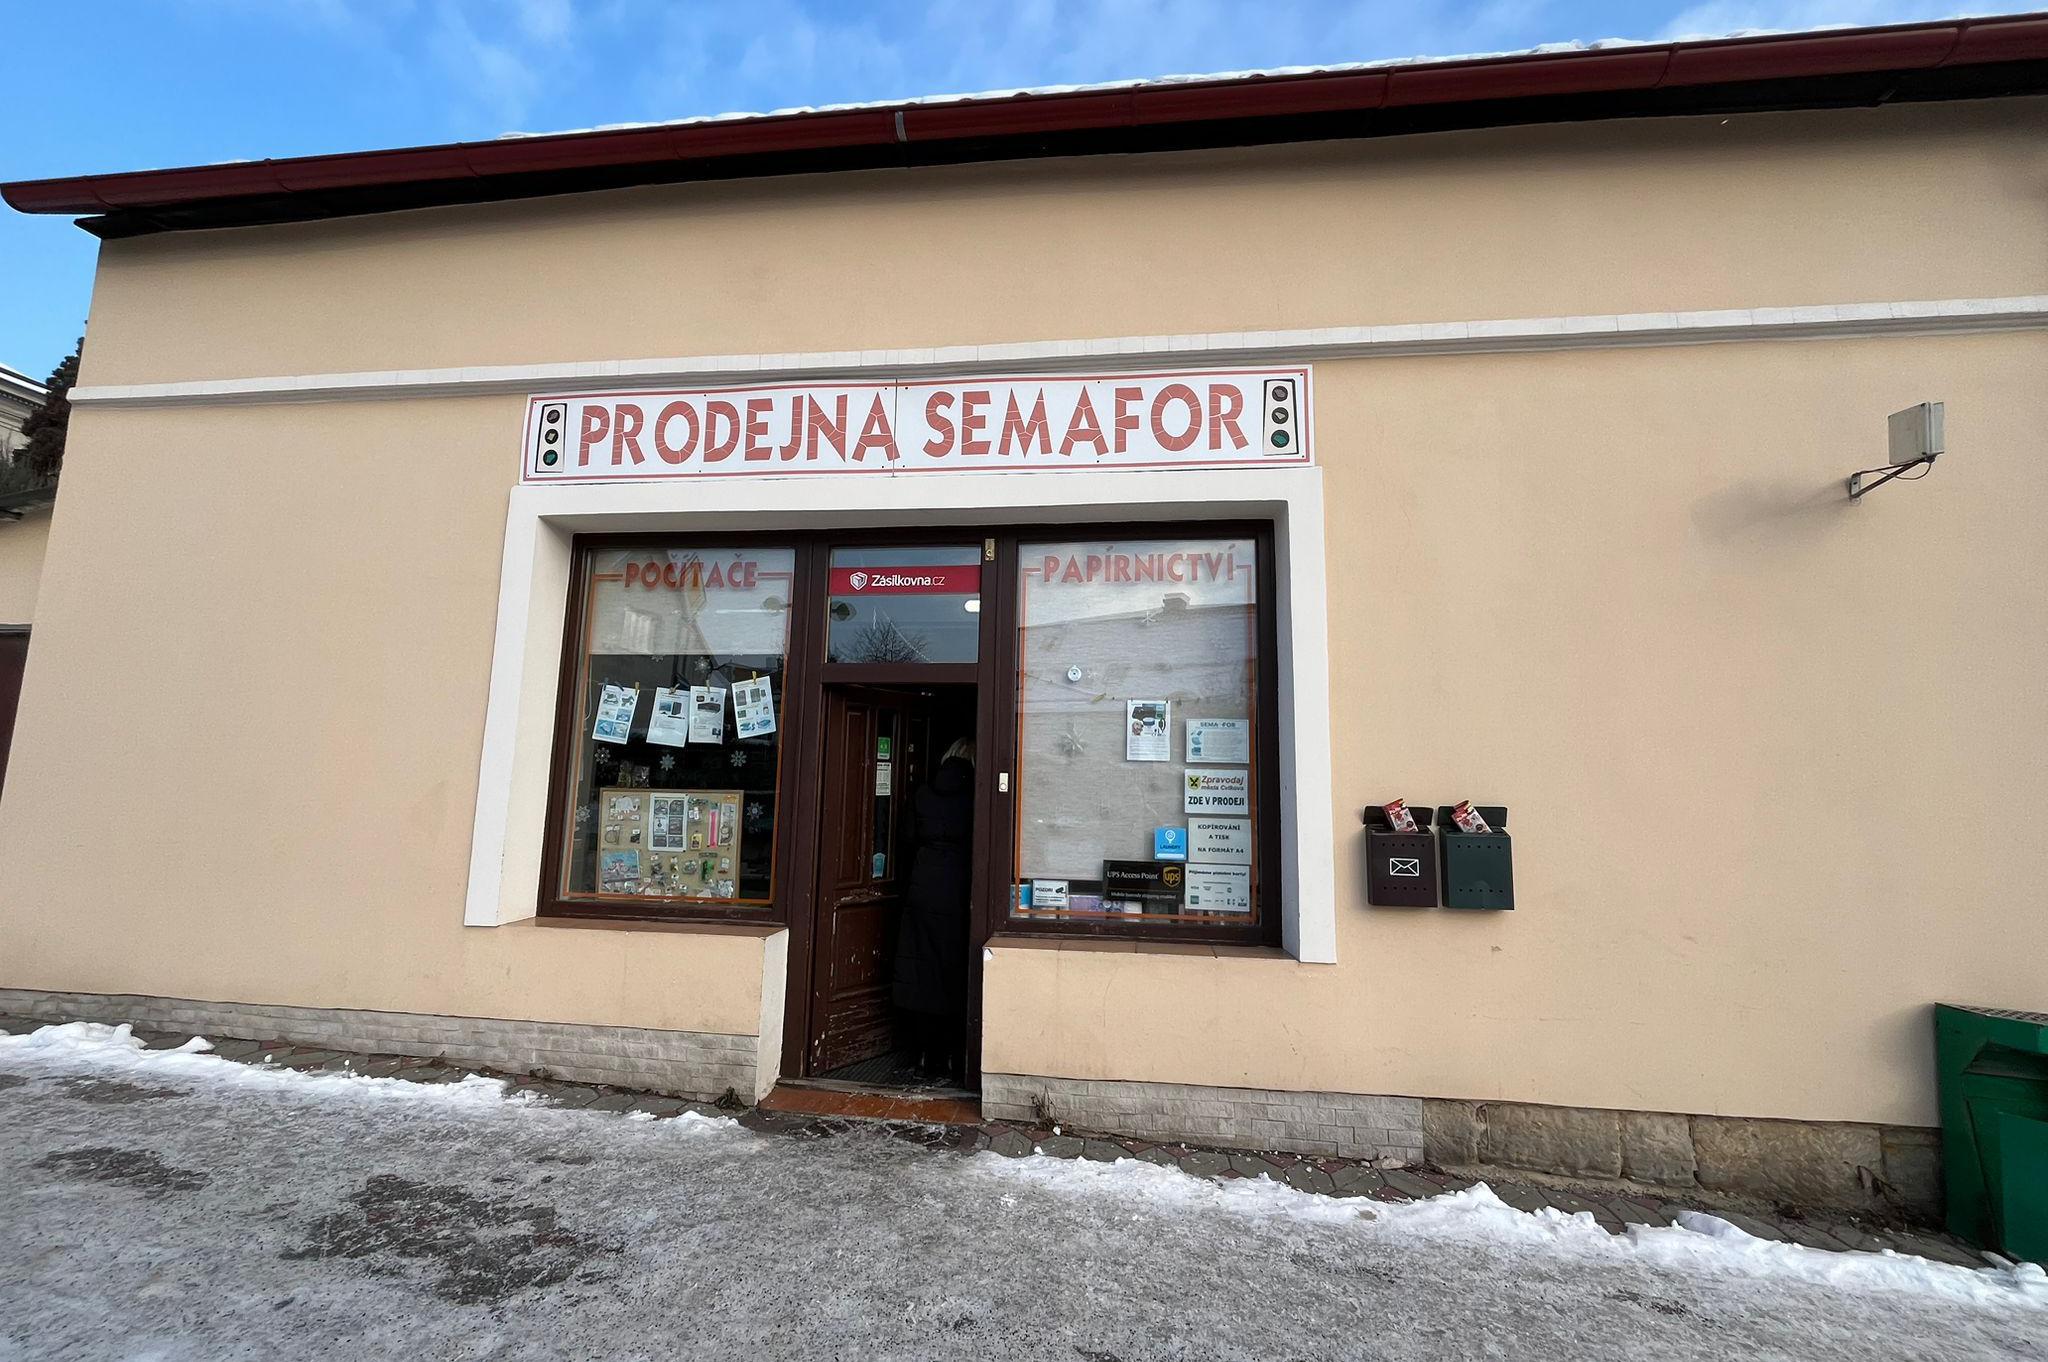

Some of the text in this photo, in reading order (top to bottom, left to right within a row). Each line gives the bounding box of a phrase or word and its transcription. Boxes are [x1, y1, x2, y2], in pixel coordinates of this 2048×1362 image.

[578, 383, 1250, 467] PRODEJNA SEMAFOR
[1043, 543, 1236, 583] PAPÍRNICTVÍ
[624, 552, 759, 589] POČÍTAČE
[871, 574, 946, 587] Zásilkovna.cz
[1201, 775, 1244, 786] Zpravodaj
[1188, 796, 1245, 806] ZDE V PRODEJI
[1197, 823, 1241, 831] KOPÍROVÁNÍ
[1121, 871, 1140, 879] Access
[1141, 872, 1158, 880] Point
